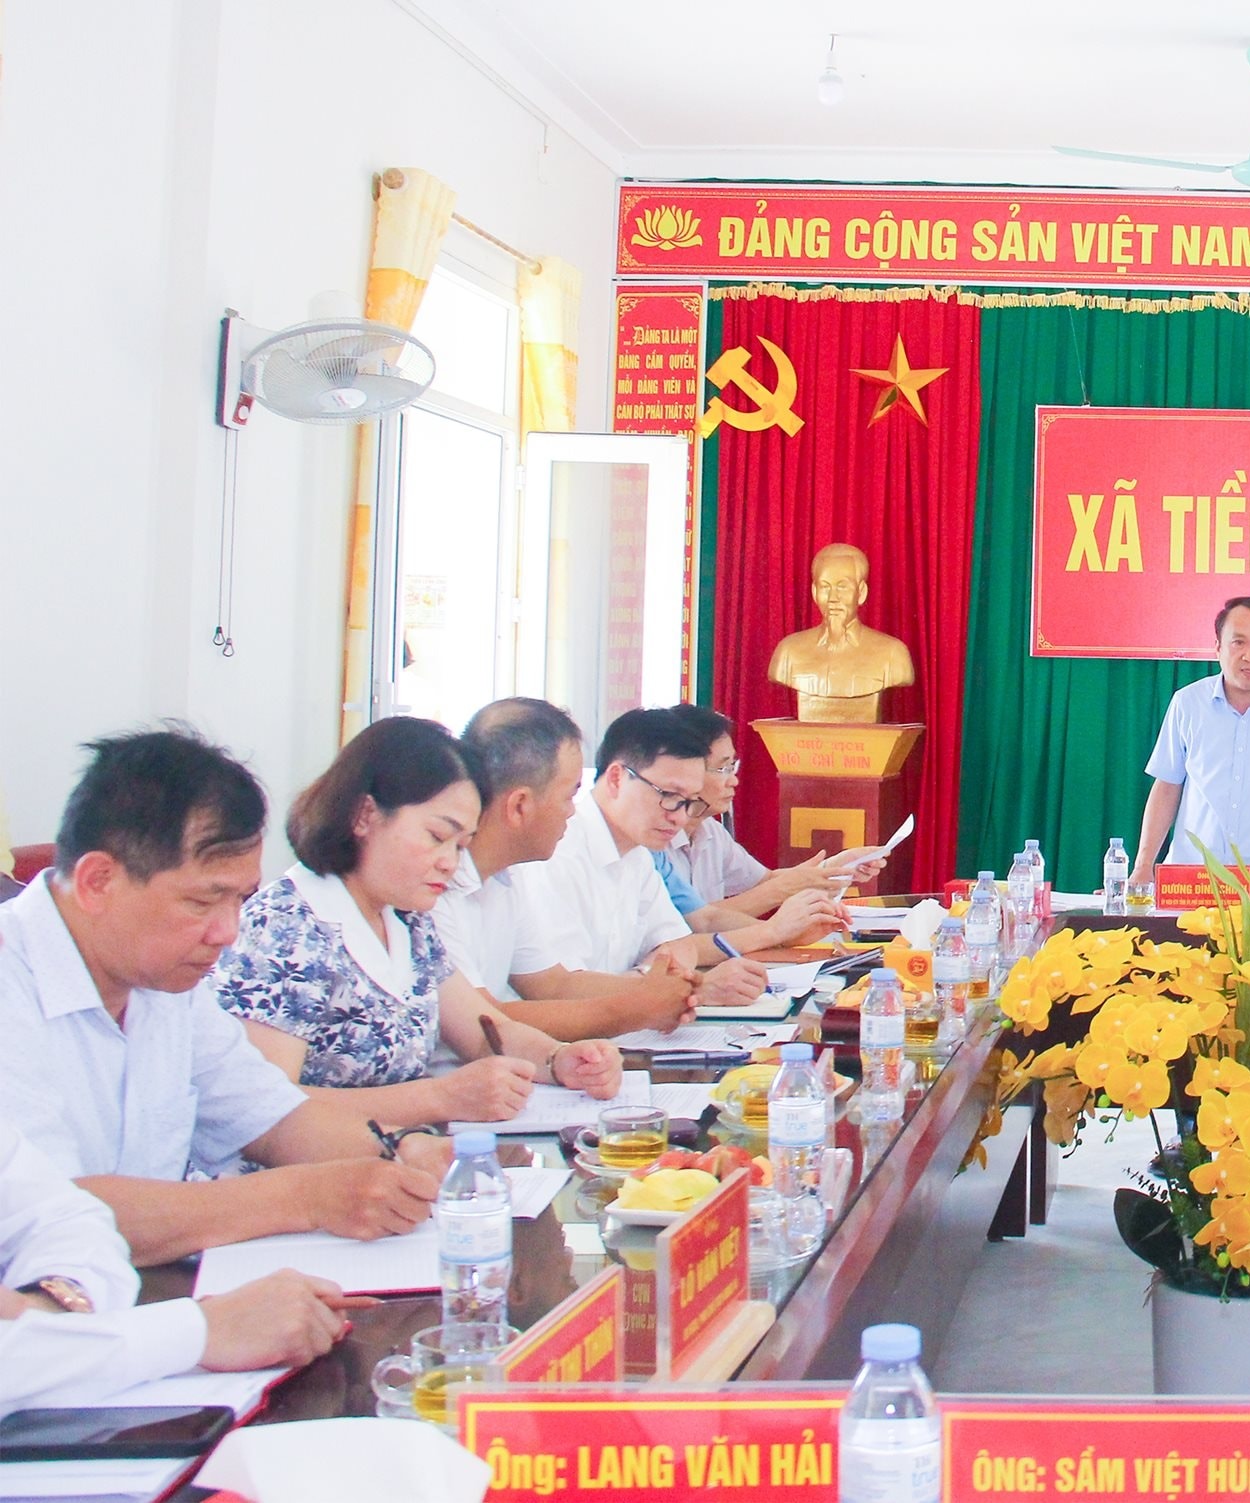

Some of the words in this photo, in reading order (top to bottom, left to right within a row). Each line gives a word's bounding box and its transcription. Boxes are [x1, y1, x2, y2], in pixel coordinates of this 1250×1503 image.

[718, 199, 831, 259] ĐẢNG
[844, 210, 957, 269] CỘNG
[971, 203, 1057, 262] SẢN
[1071, 214, 1158, 273] VIỆT
[618, 349, 640, 369] ĐẢNG
[645, 349, 663, 369] CẦM
[637, 374, 659, 394] ĐẢNG
[663, 376, 681, 394] VIÊN
[685, 376, 696, 394] VÀ
[616, 401, 633, 419] CÁN
[633, 401, 645, 423] BỘ
[645, 399, 663, 419] PHẢI
[665, 401, 683, 423] THẬT
[1064, 477, 1144, 573] XÃ
[486, 1437, 567, 1495] Ông:
[578, 1444, 674, 1489] LANG
[685, 1435, 759, 1488] VĂN
[770, 1428, 832, 1486] HẢI
[972, 1449, 1046, 1493] ÔNG:
[1134, 1450, 1199, 1501] VIỆT
